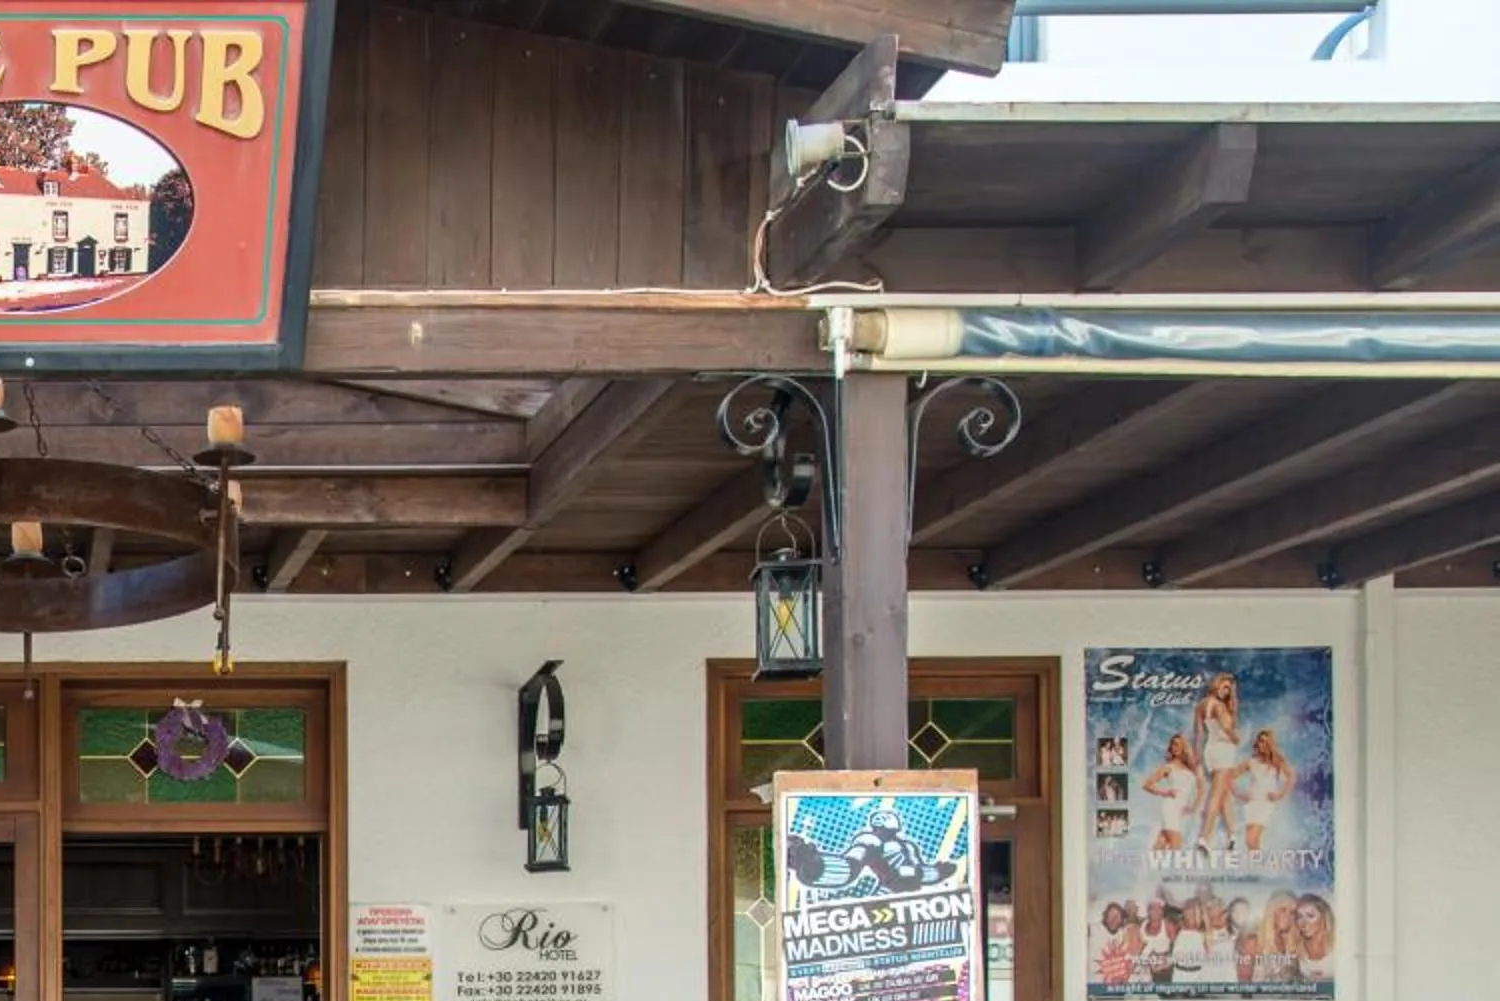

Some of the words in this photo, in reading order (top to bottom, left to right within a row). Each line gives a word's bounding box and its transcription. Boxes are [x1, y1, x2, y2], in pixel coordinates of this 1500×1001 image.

[50, 29, 265, 139] PUB
[1092, 655, 1203, 691] Status
[1149, 849, 1241, 870] WHITE
[1249, 850, 1324, 870] PARTY
[478, 907, 578, 950] Rio
[783, 906, 872, 938] MEGA
[889, 893, 973, 924] TRON
[539, 950, 579, 961] HOTEL
[786, 926, 907, 961] MADNESS
[516, 971, 556, 982] 22420
[561, 971, 601, 982] 91627
[516, 985, 556, 995] 22420
[561, 984, 601, 995] 91895
